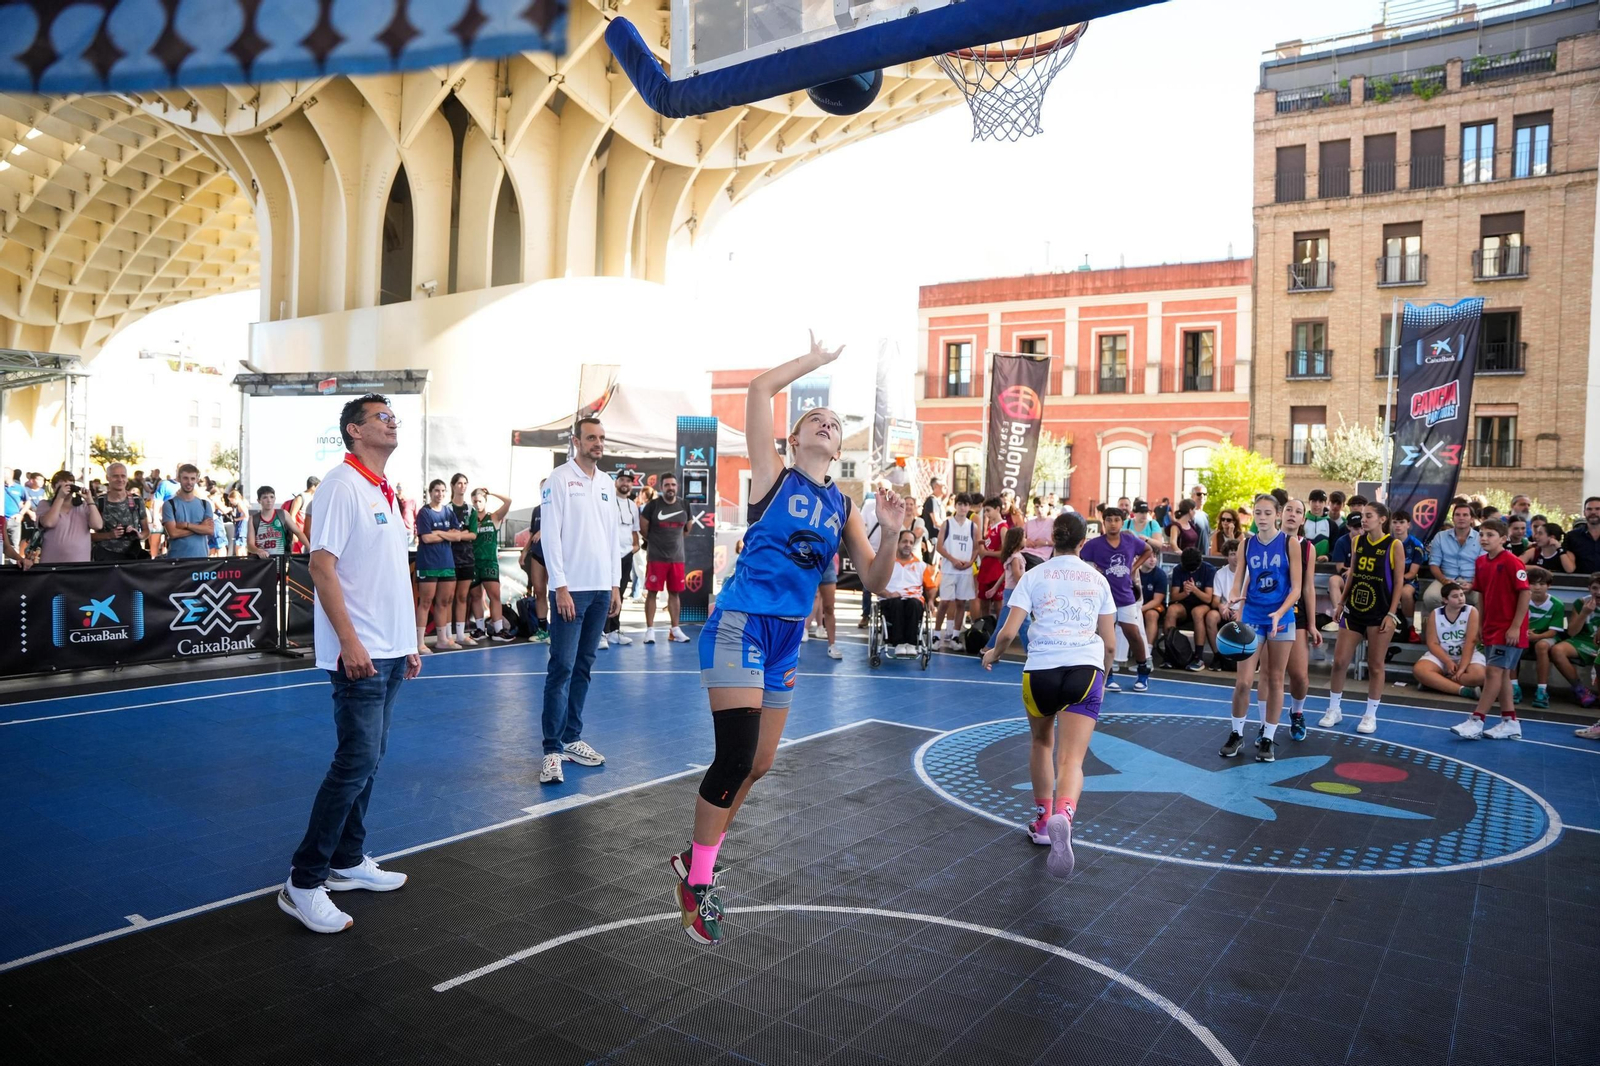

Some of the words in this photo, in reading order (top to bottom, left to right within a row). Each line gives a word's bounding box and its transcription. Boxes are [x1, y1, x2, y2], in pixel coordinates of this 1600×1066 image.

[1425, 355, 1456, 364] CaixaBank
[317, 437, 343, 446] imag
[1001, 421, 1031, 508] balonce
[1358, 556, 1376, 572] 95
[191, 570, 241, 581] CIRCUITO
[1260, 577, 1274, 588] 10
[69, 629, 129, 643] CaixaBank
[1442, 629, 1465, 640] CNS
[177, 635, 256, 655] CaixaBank
[748, 645, 761, 663] 2
